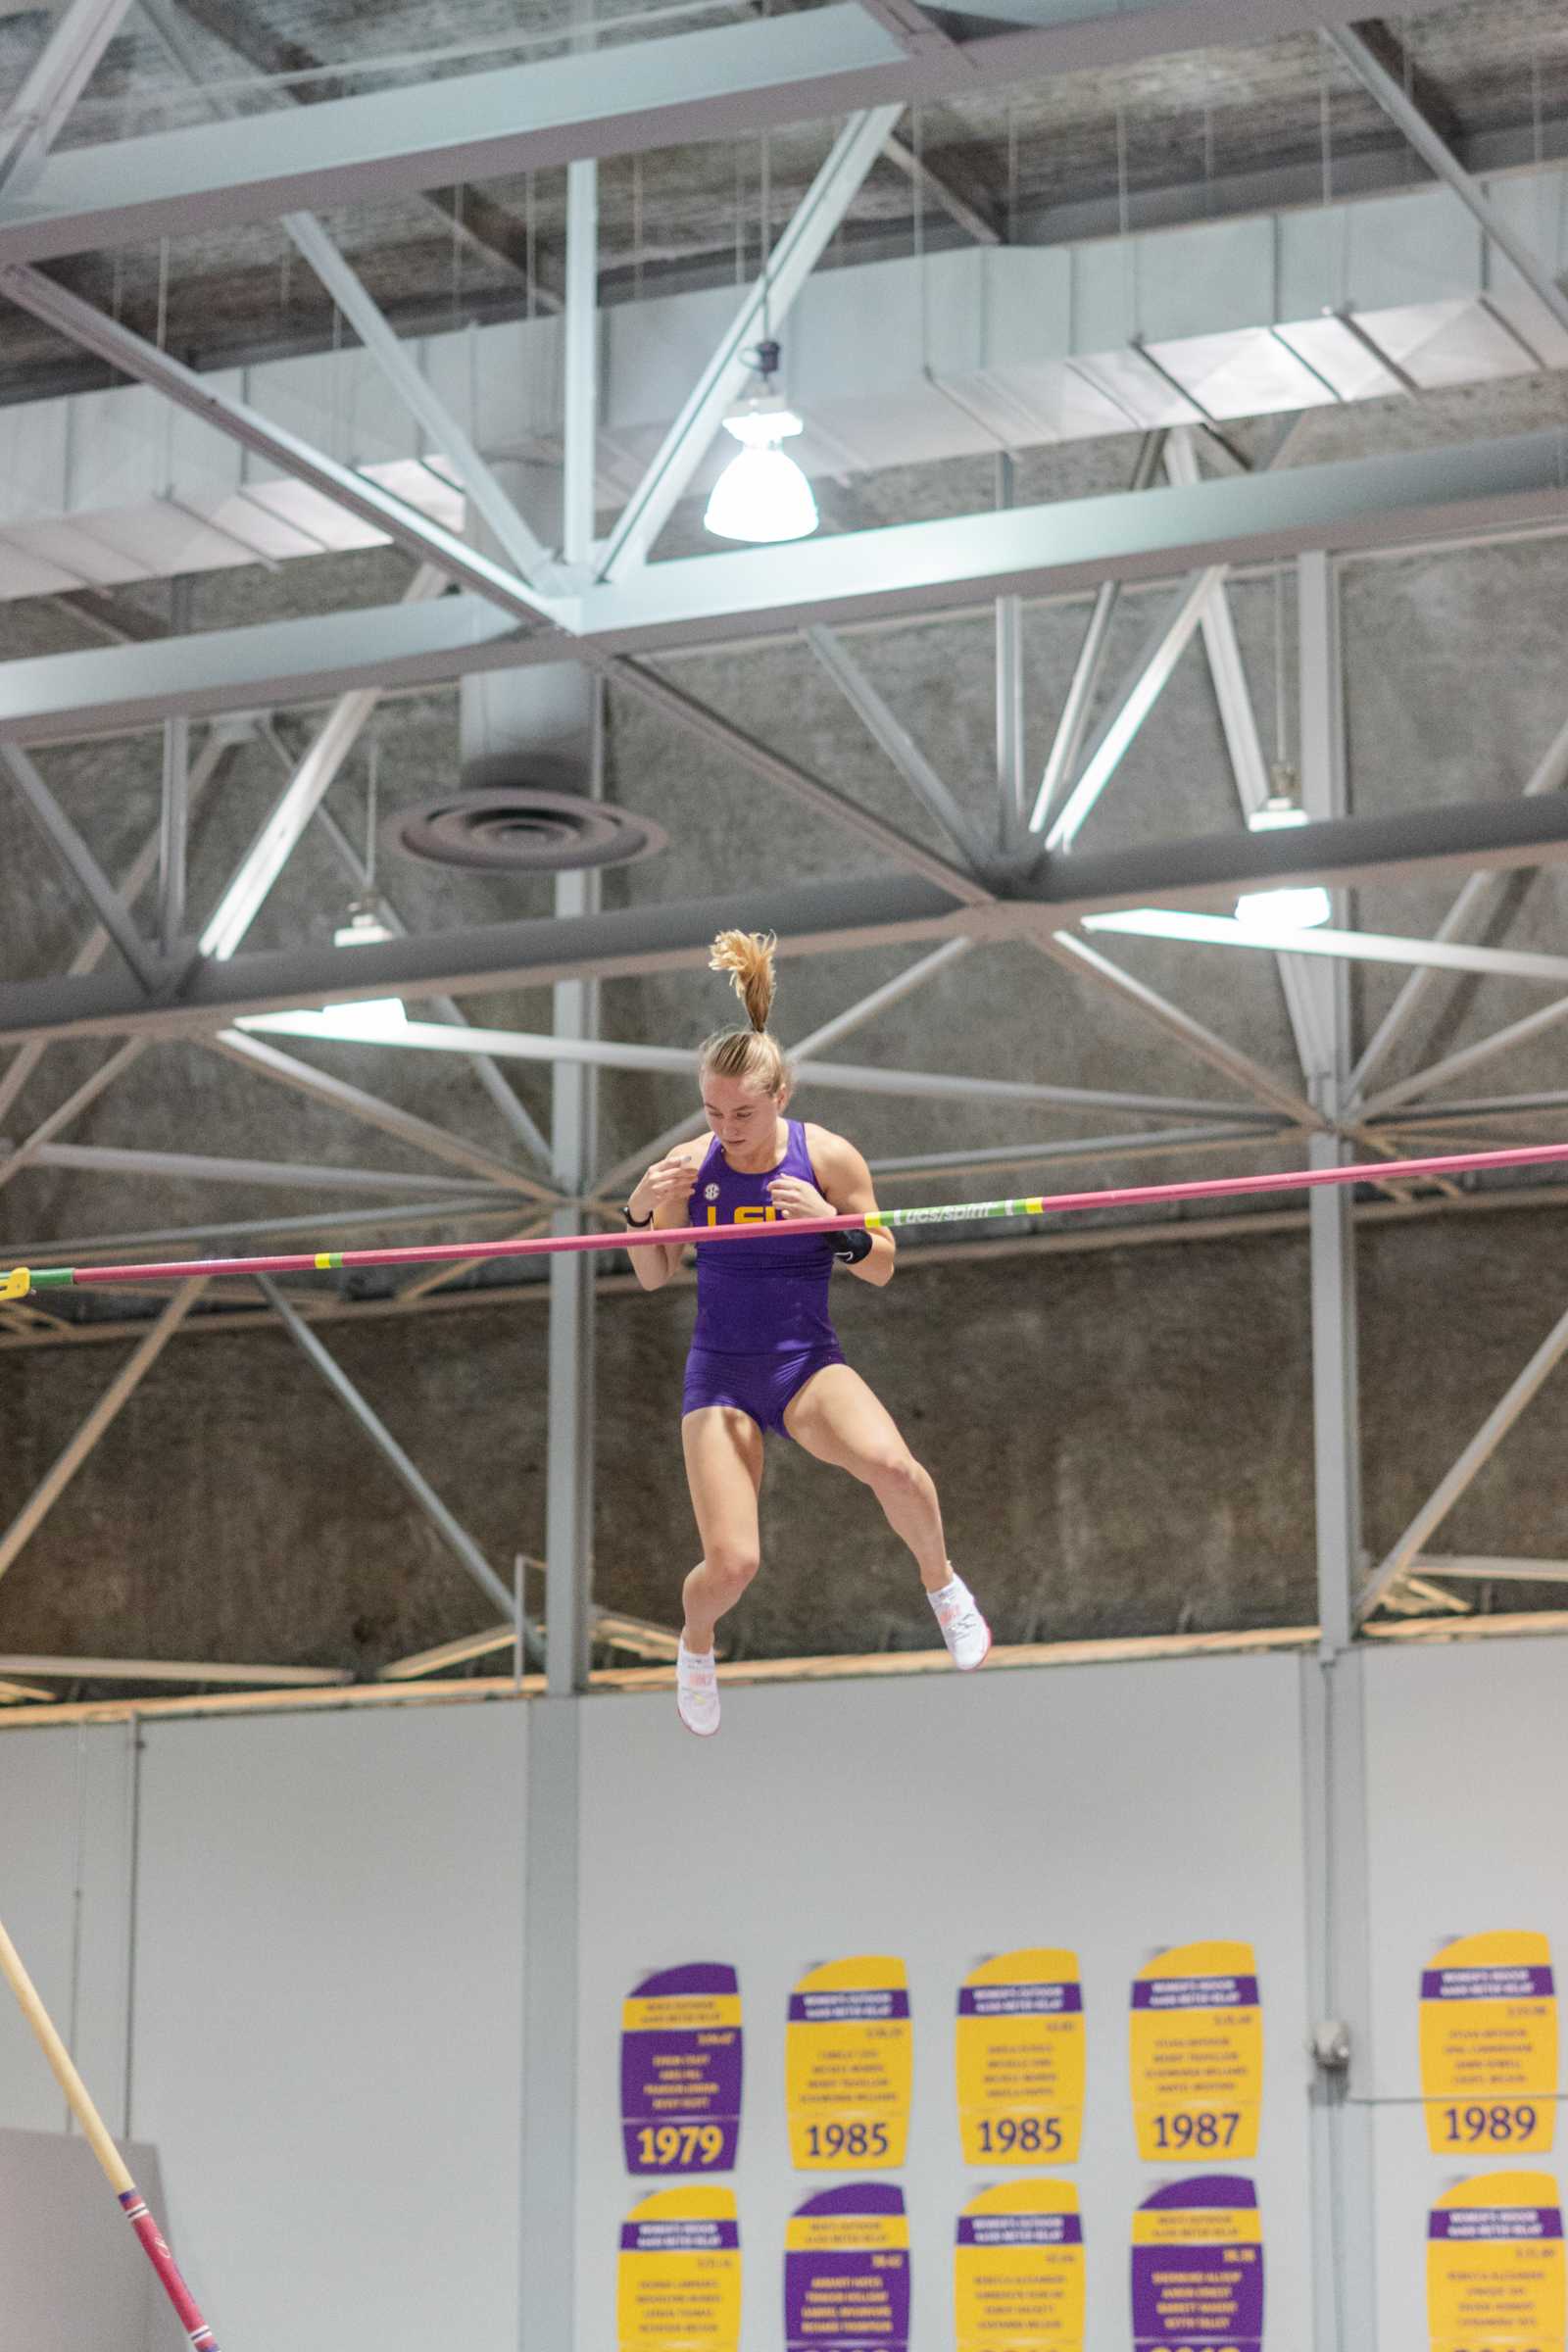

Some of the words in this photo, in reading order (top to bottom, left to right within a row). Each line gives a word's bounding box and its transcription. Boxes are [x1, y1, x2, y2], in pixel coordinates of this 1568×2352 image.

[807, 2123, 889, 2158] 1985
[978, 2118, 1062, 2154] 1985
[1153, 2113, 1241, 2148] 1987
[1446, 2105, 1537, 2141] 1989
[637, 2125, 724, 2165] 1979
